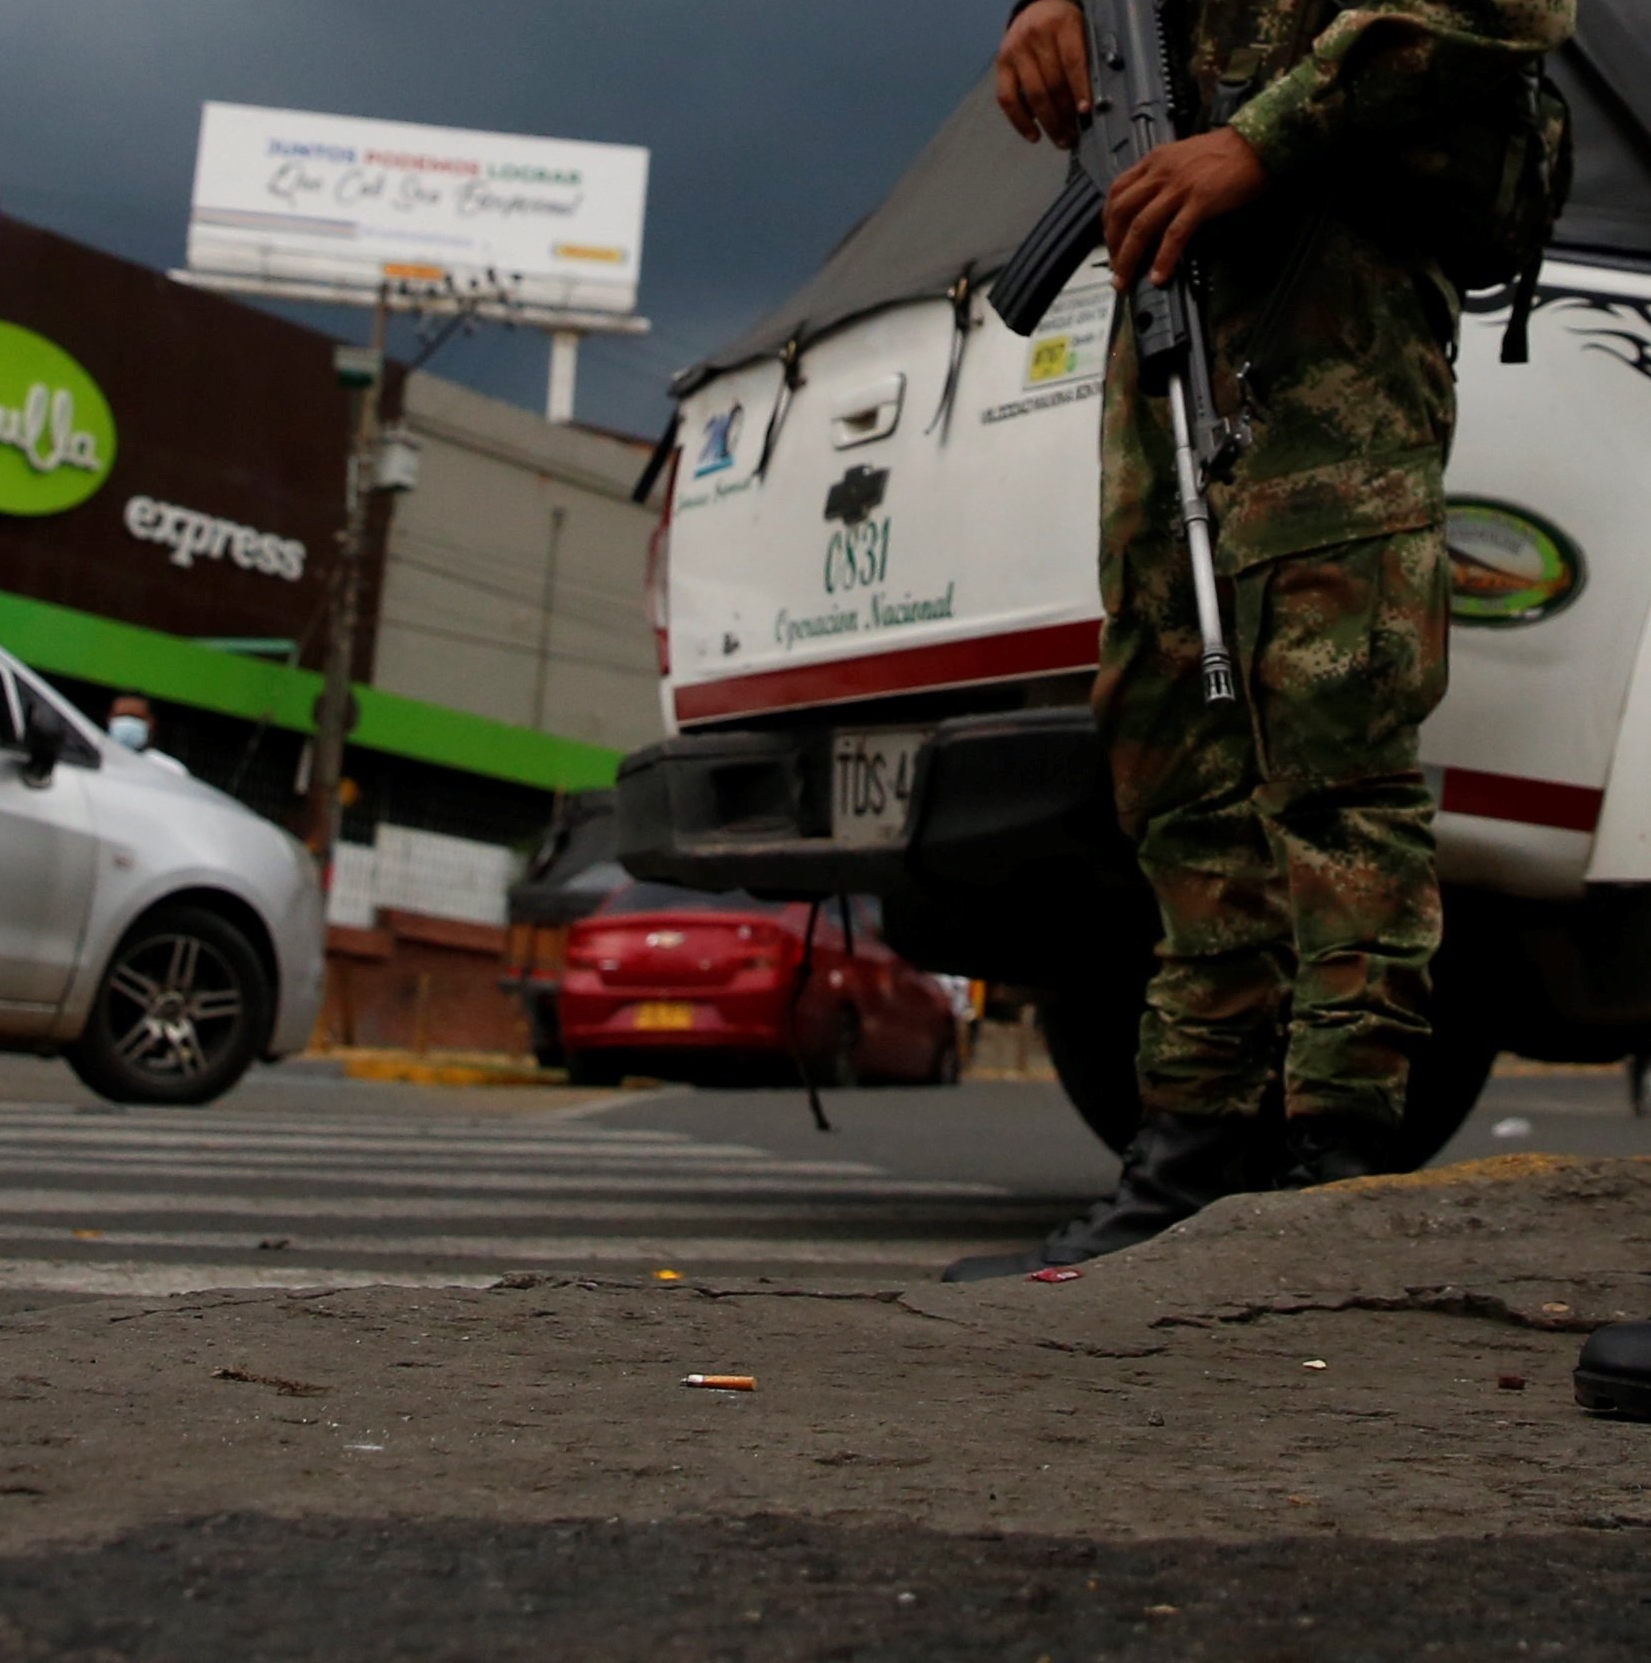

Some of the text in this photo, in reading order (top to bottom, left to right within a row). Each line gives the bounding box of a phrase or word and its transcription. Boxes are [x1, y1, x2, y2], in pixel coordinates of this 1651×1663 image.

[267, 139, 581, 187] JUNTOS PODEMOS LOGRAR
[124, 495, 306, 581] express
